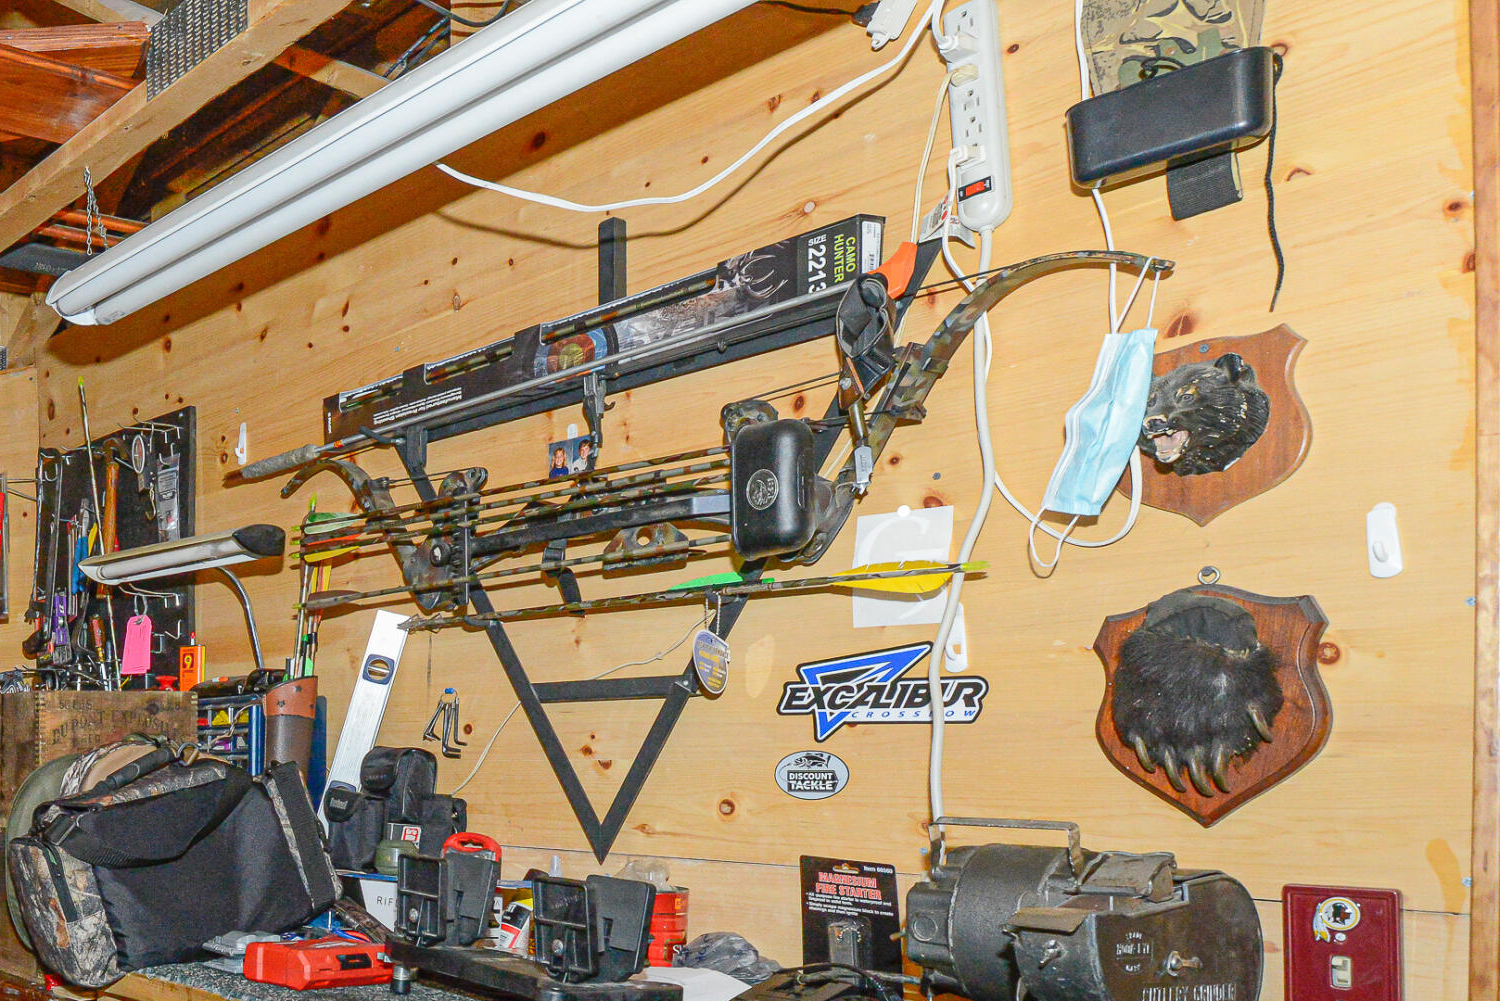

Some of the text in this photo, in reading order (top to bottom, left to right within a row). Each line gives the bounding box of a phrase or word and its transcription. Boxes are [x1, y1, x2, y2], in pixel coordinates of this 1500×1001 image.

[808, 234, 827, 246] SIZE
[834, 234, 845, 283] HUNTER
[846, 236, 856, 273] CAMO
[808, 244, 827, 294] 2213
[851, 709, 977, 719] CROSSOW
[788, 772, 833, 780] DISCOUNT
[789, 780, 834, 790] TACKLE
[818, 872, 877, 888] MAGNESIUM
[815, 882, 837, 895] FIRE
[839, 886, 882, 900] STARTER
